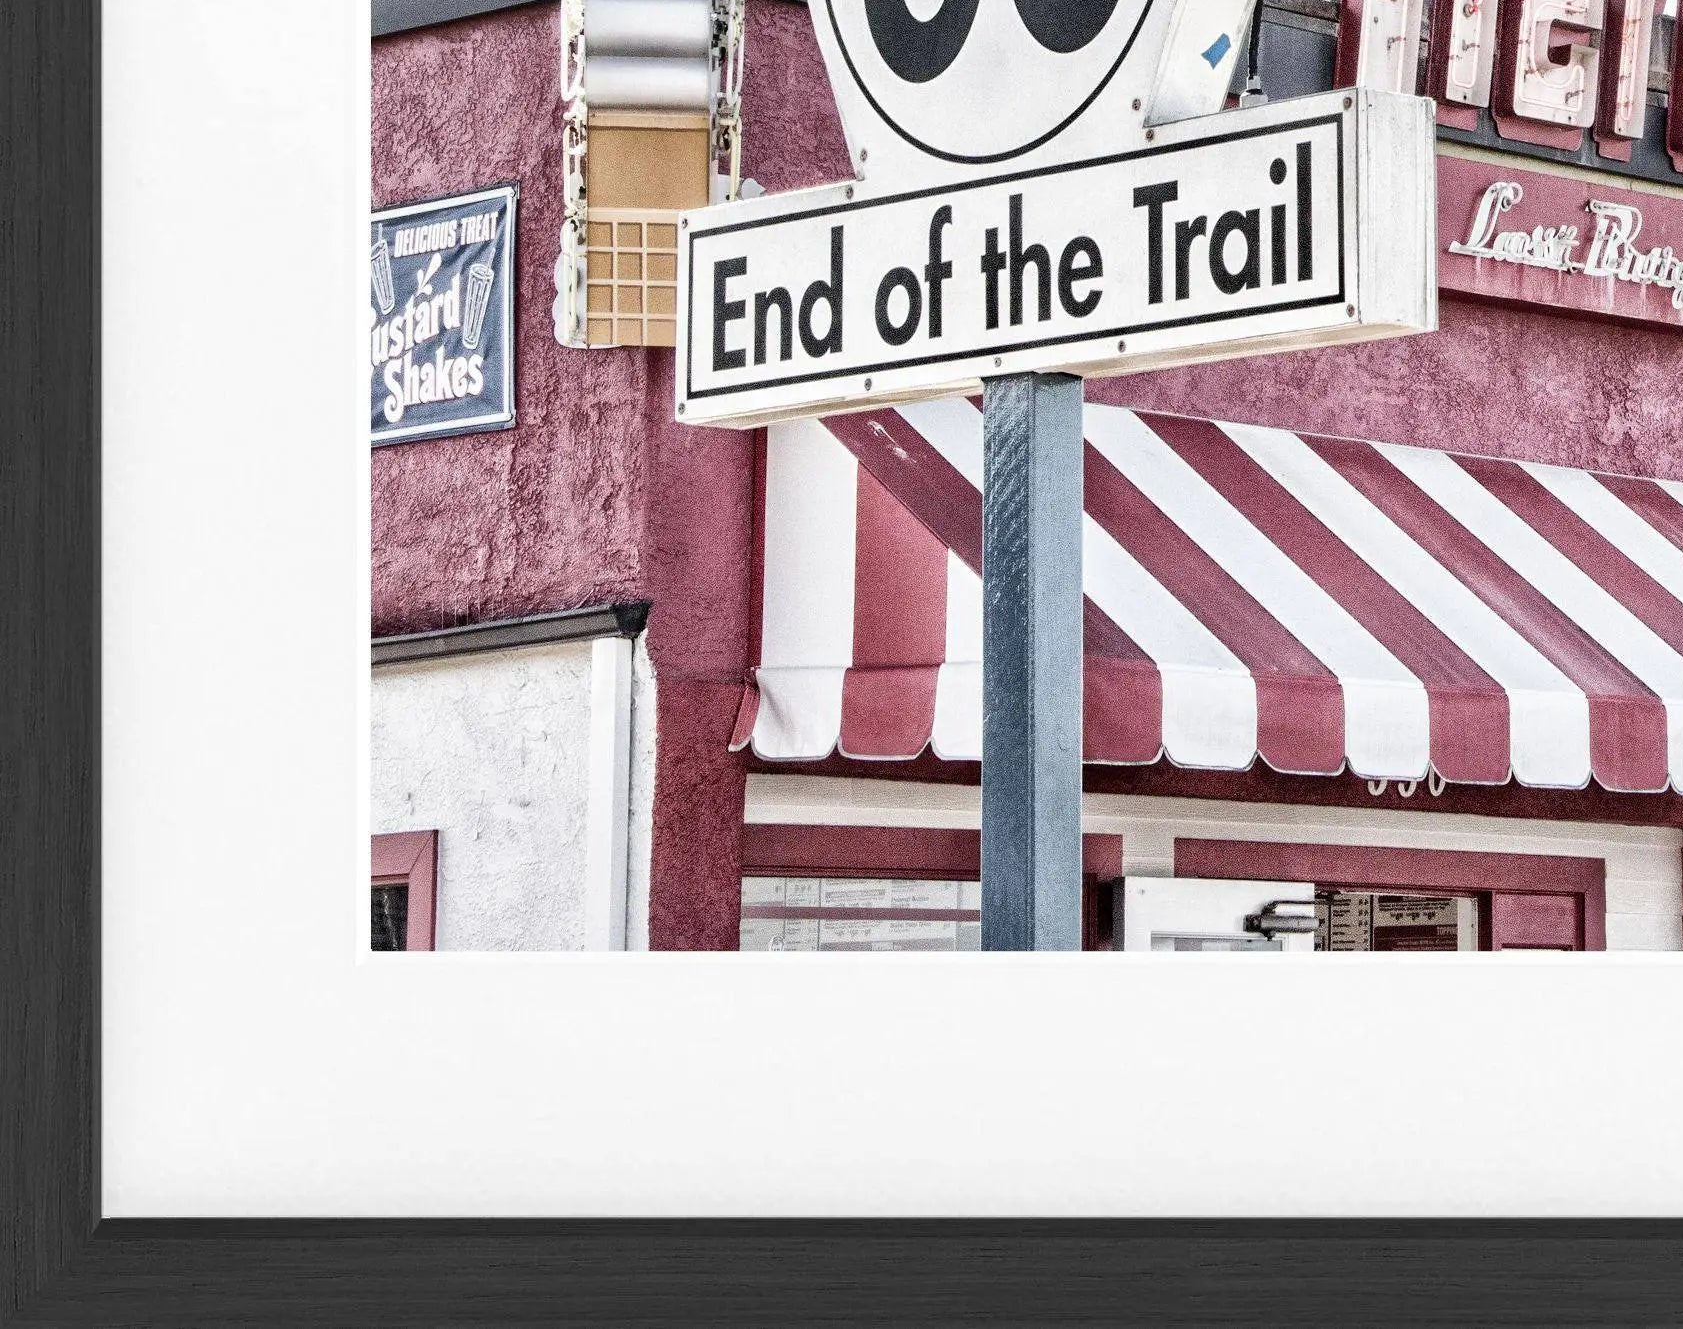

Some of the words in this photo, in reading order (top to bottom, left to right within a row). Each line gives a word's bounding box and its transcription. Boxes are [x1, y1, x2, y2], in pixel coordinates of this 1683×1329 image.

[394, 219, 458, 257] DELICIOUS
[460, 211, 500, 246] TREAT
[711, 225, 845, 372] End
[874, 204, 953, 347] of
[981, 194, 1104, 330] the
[1133, 140, 1314, 305] Trail
[1448, 181, 1582, 275] Last
[371, 272, 460, 377] ustard
[384, 344, 484, 423] Shakes
